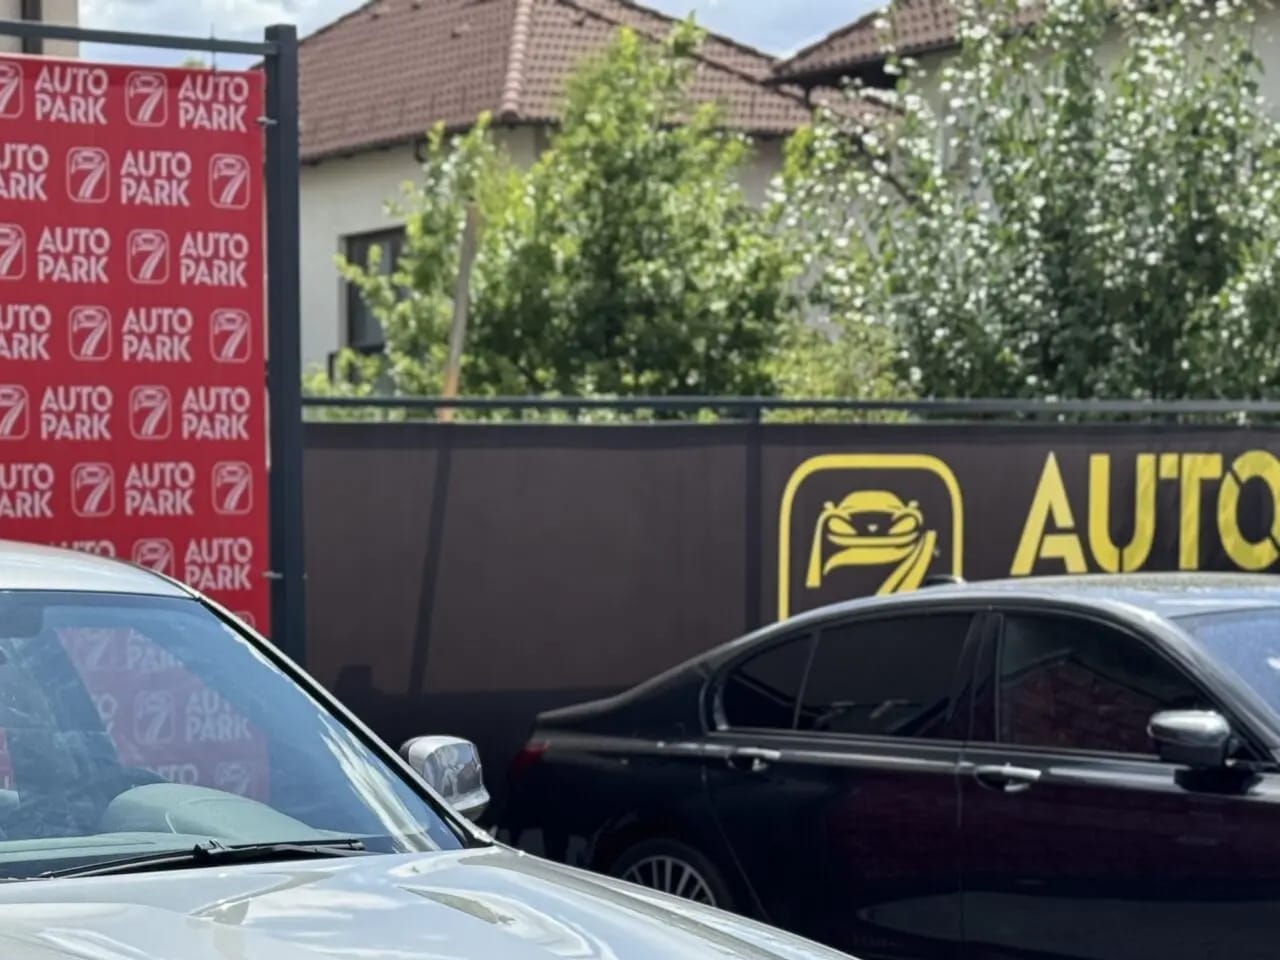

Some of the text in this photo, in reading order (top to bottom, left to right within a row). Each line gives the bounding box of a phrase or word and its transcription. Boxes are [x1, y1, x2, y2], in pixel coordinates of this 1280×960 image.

[36, 63, 107, 95] AUTO
[178, 72, 248, 103] AUTO
[36, 89, 107, 124] PARK
[179, 101, 246, 132] PARK
[120, 151, 191, 179] AUTO
[121, 177, 189, 206] PARK
[37, 227, 110, 255] AUTO
[180, 232, 248, 261] AUTO
[38, 254, 108, 283] PARK
[180, 256, 246, 287] PARK
[122, 308, 192, 334] AUTO
[123, 334, 191, 362] PARK
[40, 386, 112, 413] AUTO
[182, 386, 250, 414] AUTO
[40, 410, 111, 440] PARK
[182, 409, 248, 440] PARK
[125, 462, 195, 489] AUTO
[125, 488, 193, 515] PARK
[1010, 450, 1280, 576] AUTO
[184, 537, 252, 563] AUTO
[184, 566, 249, 590] PARK
